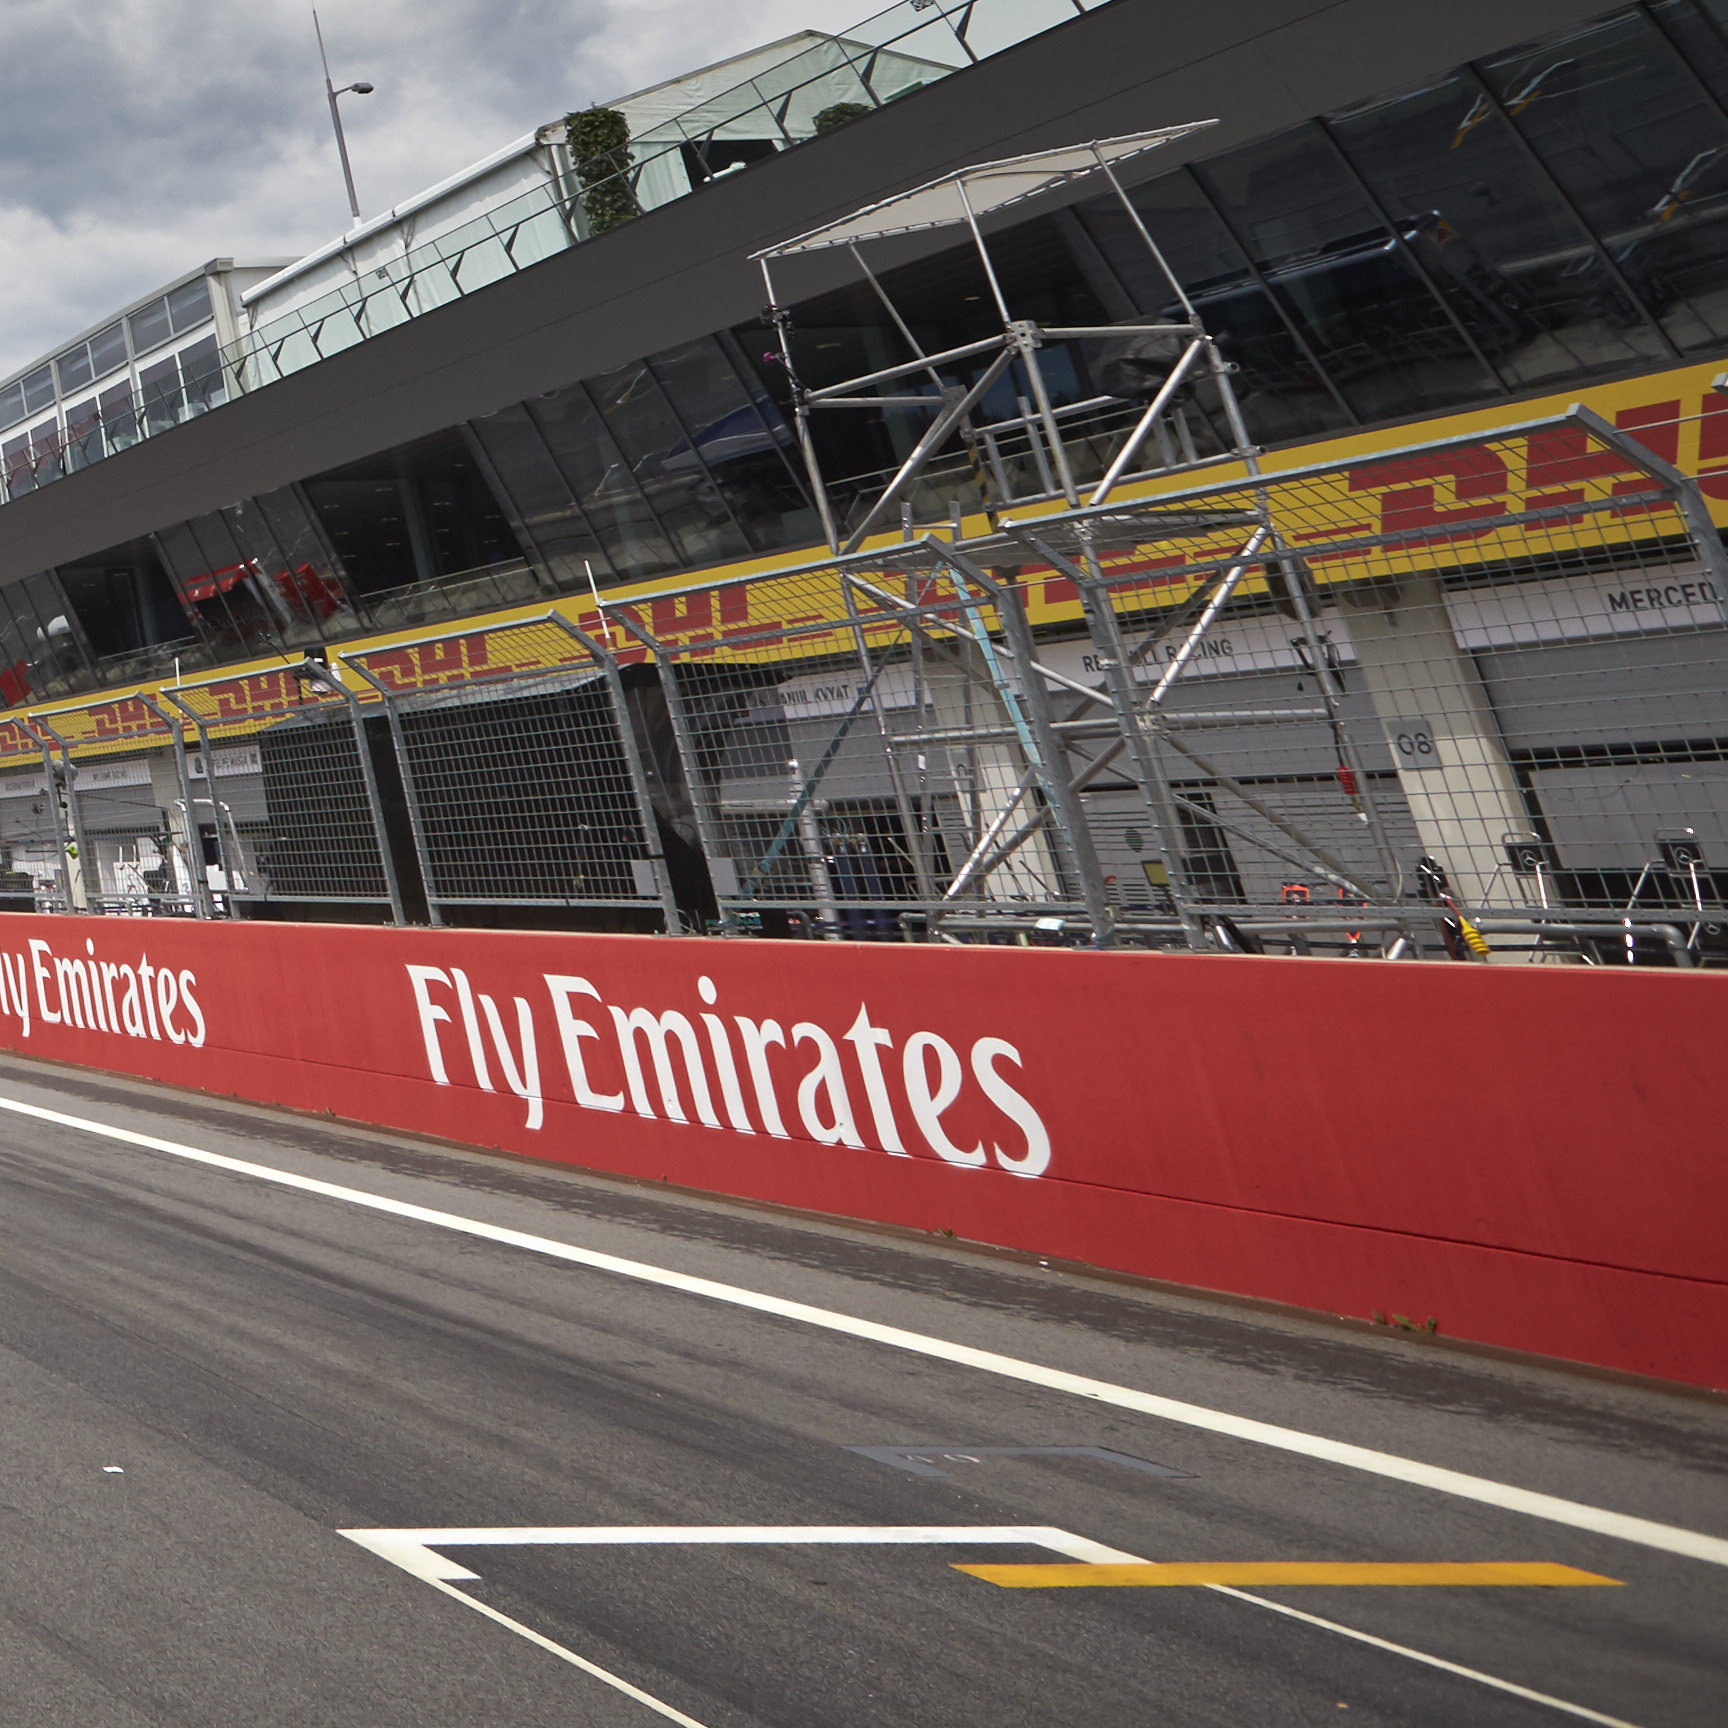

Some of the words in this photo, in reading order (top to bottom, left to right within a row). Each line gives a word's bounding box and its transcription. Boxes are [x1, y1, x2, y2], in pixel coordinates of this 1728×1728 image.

[1397, 732, 1431, 755] 08
[28, 938, 206, 1048] Emirates
[405, 964, 544, 1129] Fly
[543, 974, 1052, 1180] Emirates
